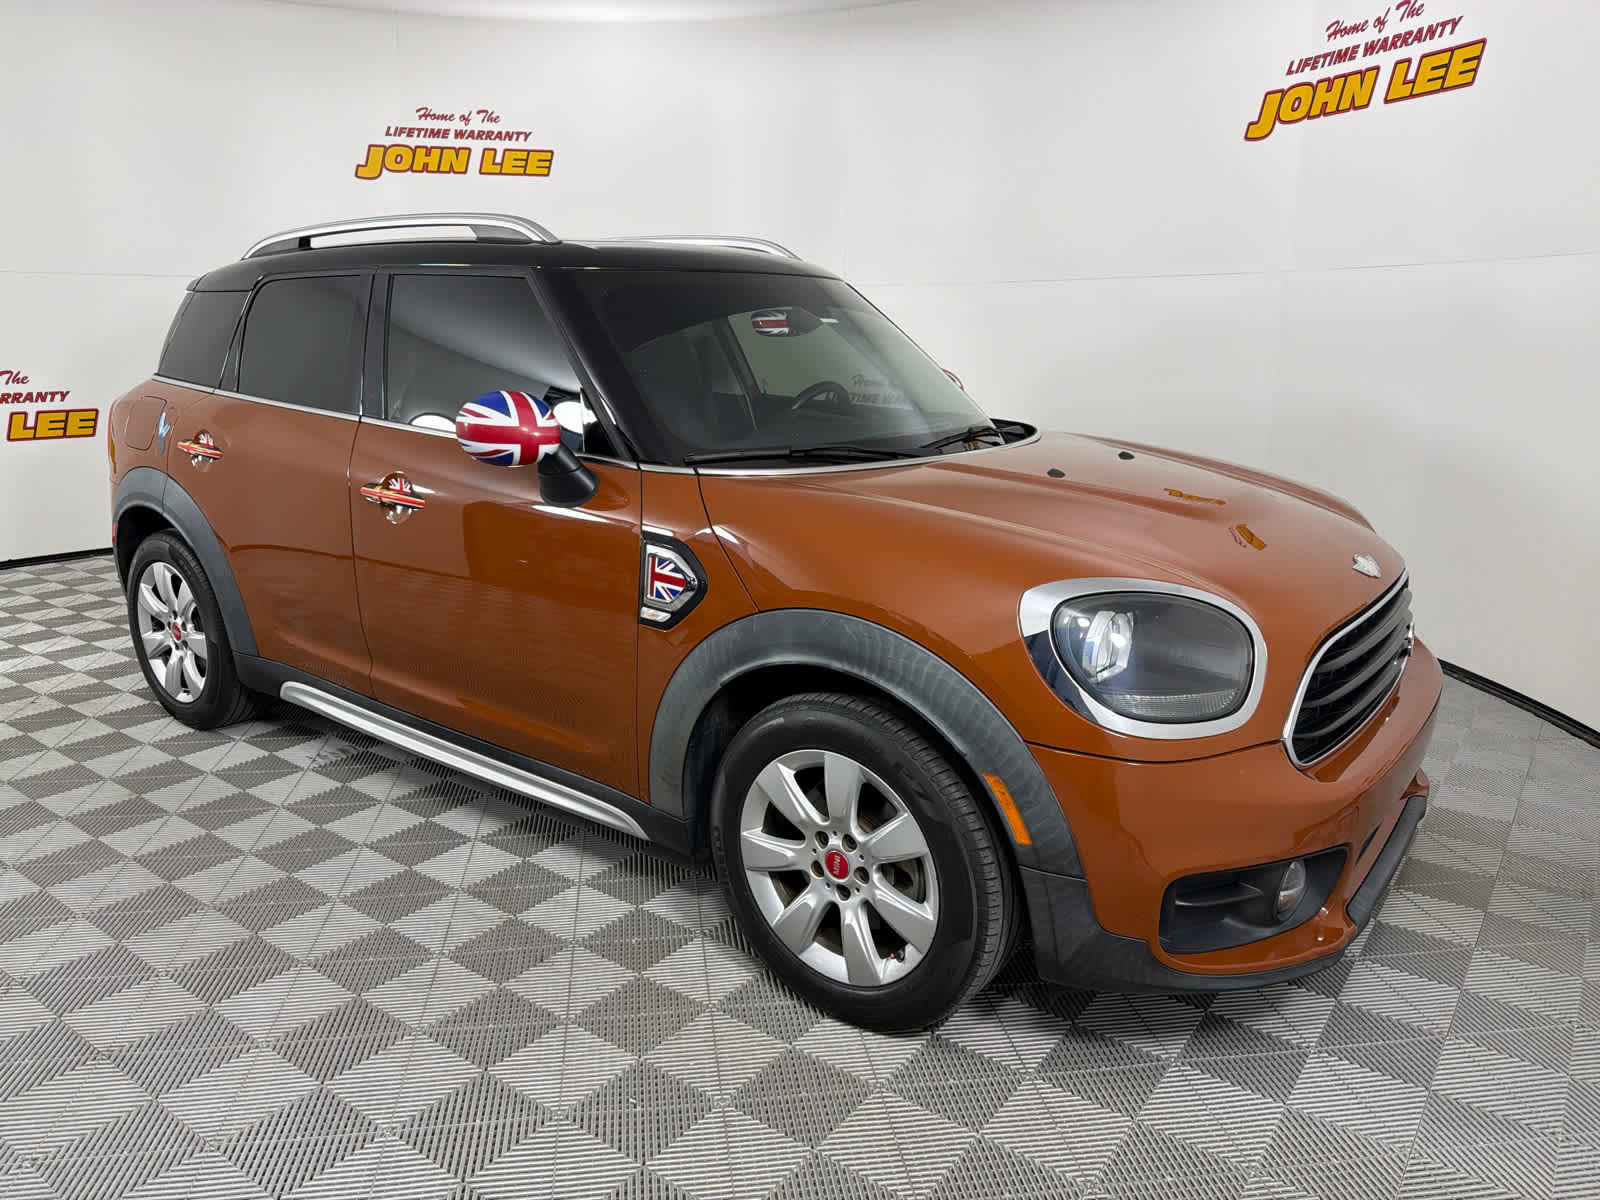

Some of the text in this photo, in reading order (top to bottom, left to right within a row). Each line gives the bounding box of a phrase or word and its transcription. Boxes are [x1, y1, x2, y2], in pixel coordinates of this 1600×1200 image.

[1325, 0, 1425, 41] Home of The
[1285, 15, 1464, 76] LIFETIME WARRANTY
[1244, 37, 1488, 142] JOHN LEE
[385, 126, 533, 142] LIFETIME WARRANTY
[415, 107, 501, 126] Home of The
[355, 144, 555, 180] JOHN LEE
[0, 370, 30, 385] The
[6, 408, 100, 442] LEE
